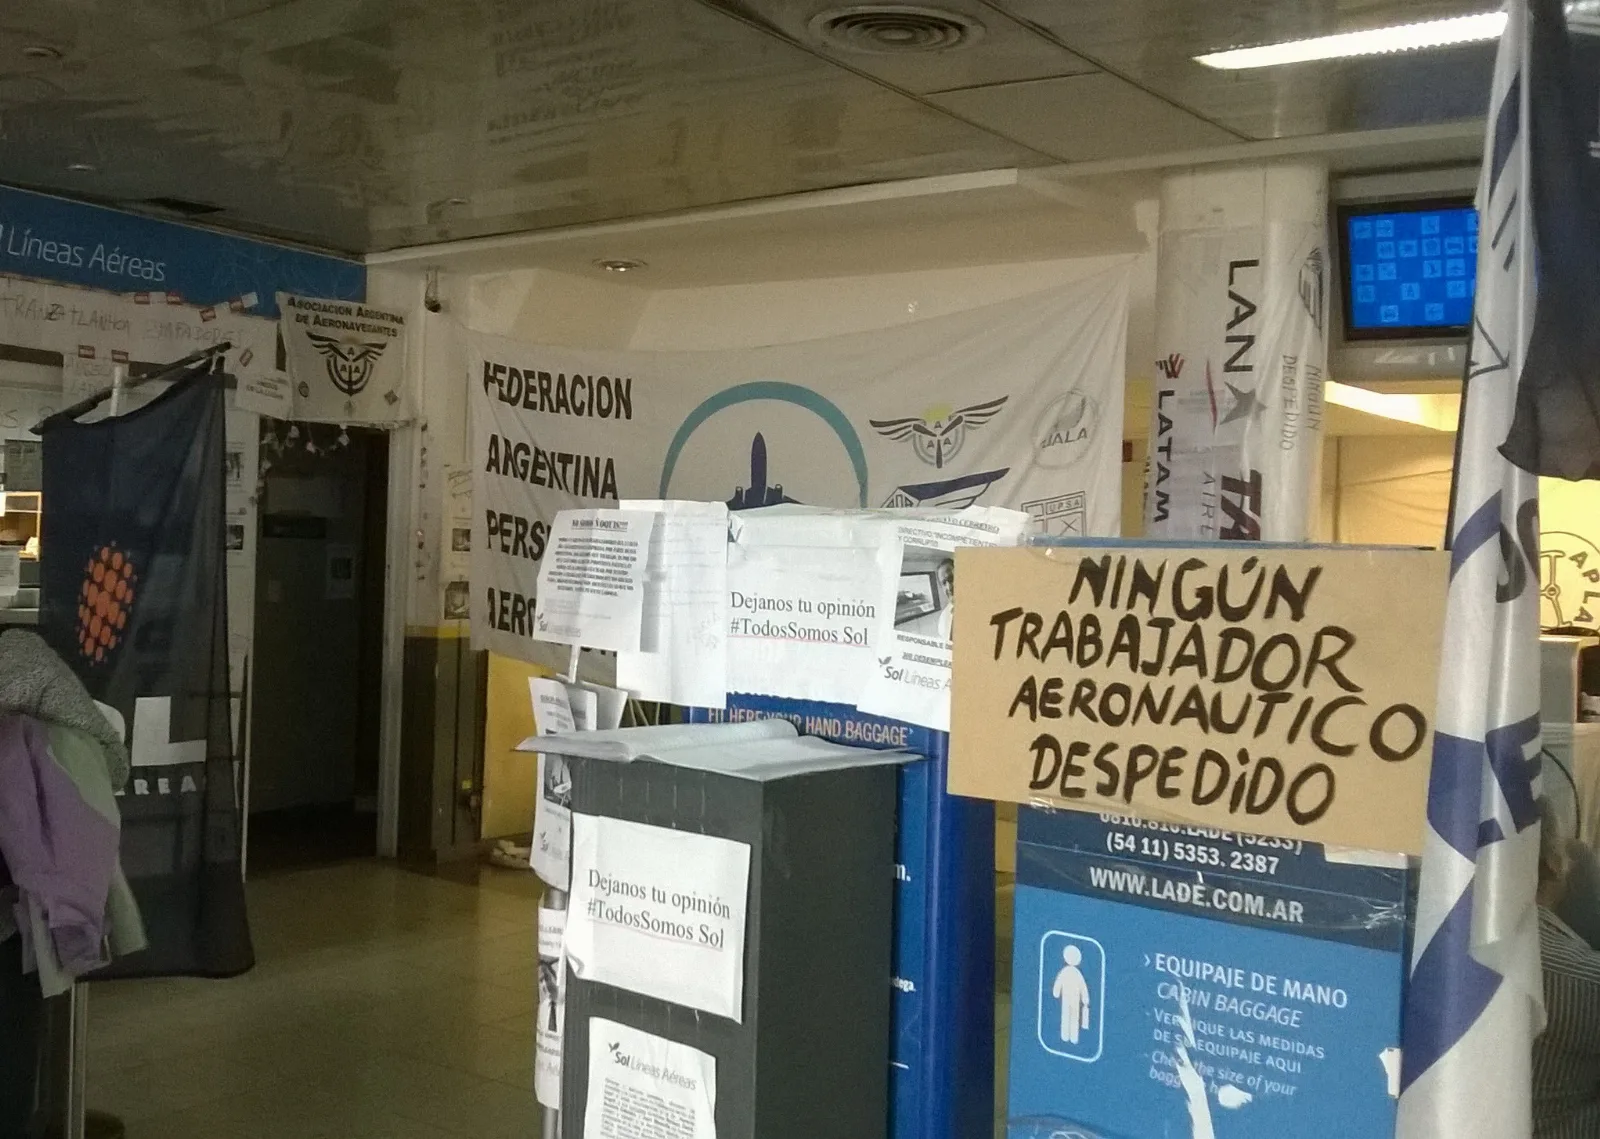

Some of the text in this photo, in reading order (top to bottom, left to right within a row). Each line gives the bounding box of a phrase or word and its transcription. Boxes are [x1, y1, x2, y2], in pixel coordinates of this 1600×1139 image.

[7, 226, 85, 267] Líneas
[88, 244, 167, 282] Aéreas
[287, 297, 405, 325] ASOCIACION ARGENTINA
[1223, 258, 1260, 374] LAN
[483, 360, 633, 420] FEDERACION
[485, 433, 620, 500] ARGENTINA
[1154, 390, 1175, 523] LATAM
[485, 508, 551, 562] PERS
[731, 591, 876, 619] Dejanos tu opinión
[1068, 555, 1323, 623] NINGÚN
[730, 618, 868, 646] #TodosSomos Sol
[988, 606, 1364, 693] TRABAJADOR
[884, 665, 904, 683] Sol
[904, 667, 941, 690] Líneas
[805, 715, 841, 737] HAND
[845, 720, 908, 746] BAGGAGE
[1007, 676, 1428, 763] AERONAUTICO
[1106, 831, 1280, 875] (54 11) 5353. 2387
[588, 868, 731, 920] Dejanos tu opinión
[1089, 866, 1304, 924] WWW.LADE.COM.AR
[587, 898, 694, 941] #TodosSomos
[699, 924, 724, 949] Sol
[1155, 952, 1348, 1009] EQUIPAJE DE MANO
[1214, 994, 1303, 1029] BAGGAGE
[614, 1051, 630, 1068] Sol
[1154, 1028, 1171, 1044] DE
[1197, 1040, 1262, 1065] EQUIPAJE
[1229, 1027, 1256, 1044] LAS
[1259, 1034, 1326, 1060] MEDIDAS
[1218, 1067, 1245, 1084] size
[1247, 1073, 1262, 1090] of
[1264, 1080, 1297, 1097] your
